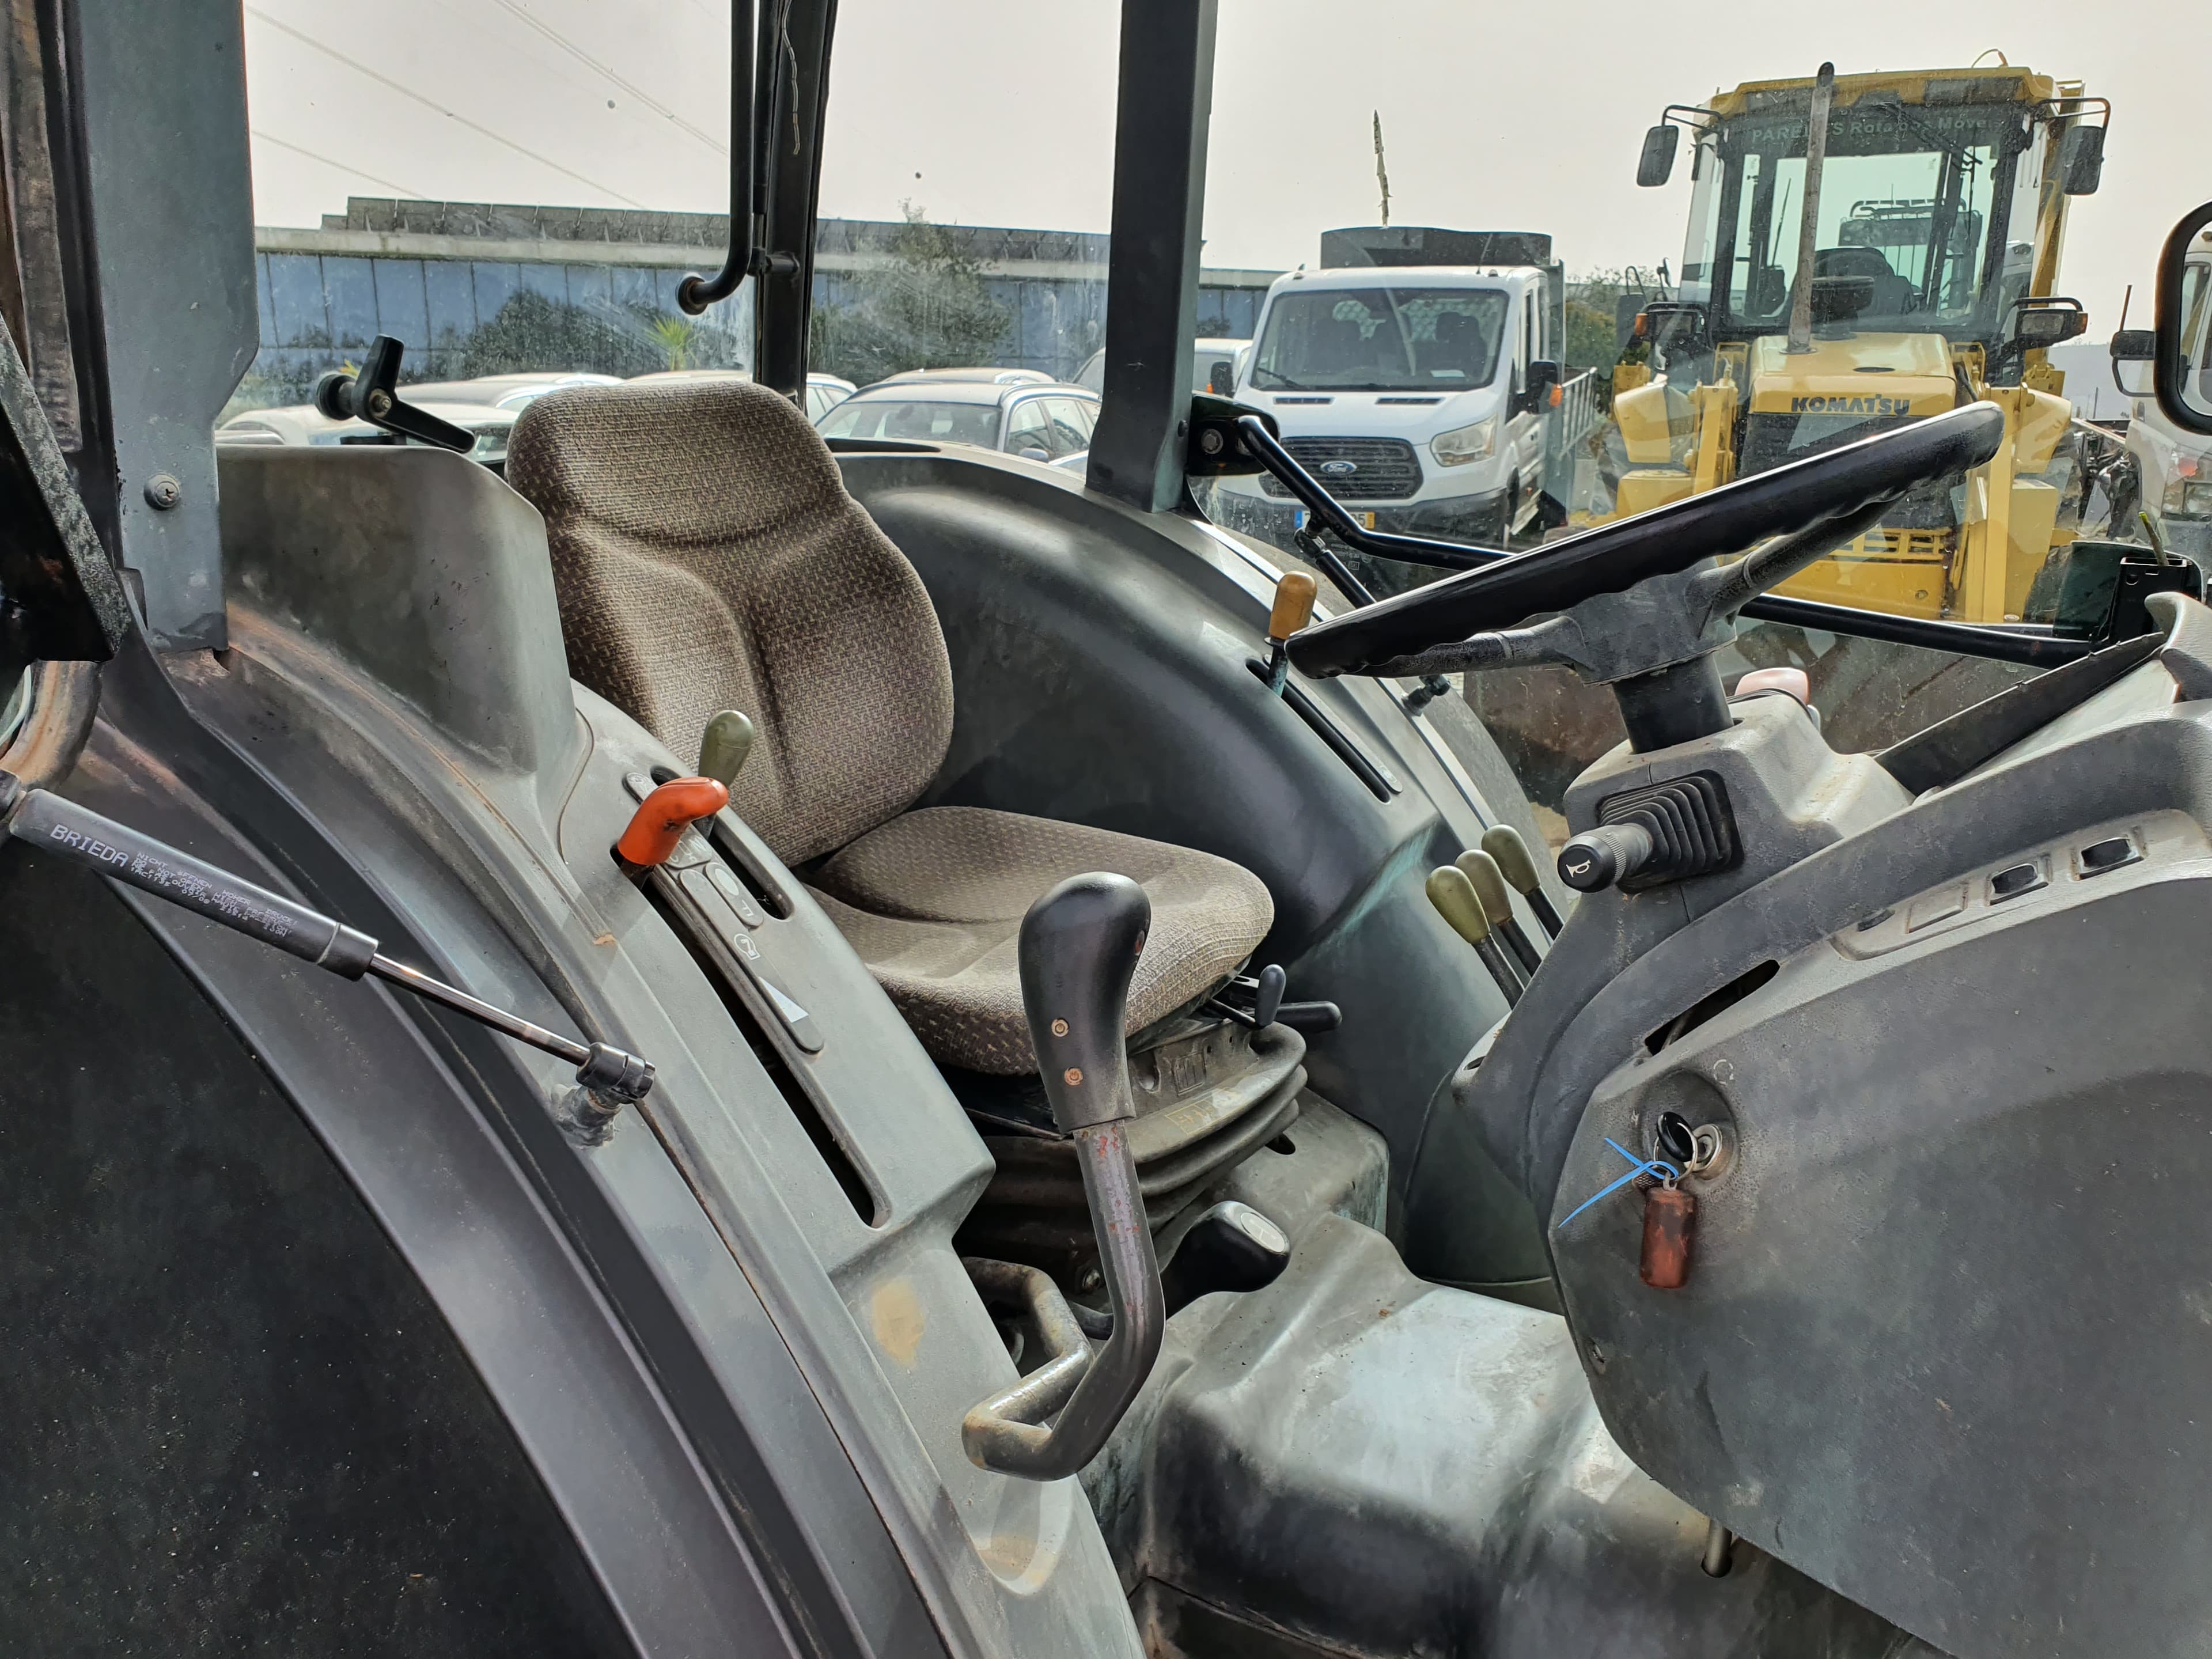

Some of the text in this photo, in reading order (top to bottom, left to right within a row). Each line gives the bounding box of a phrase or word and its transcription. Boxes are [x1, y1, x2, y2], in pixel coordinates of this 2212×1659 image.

[1791, 393, 1911, 415] KOMATSU
[50, 823, 130, 868] BRIEDA
[136, 852, 168, 868] NICHT
[221, 889, 251, 906] HOHER
[156, 868, 176, 878] NOT
